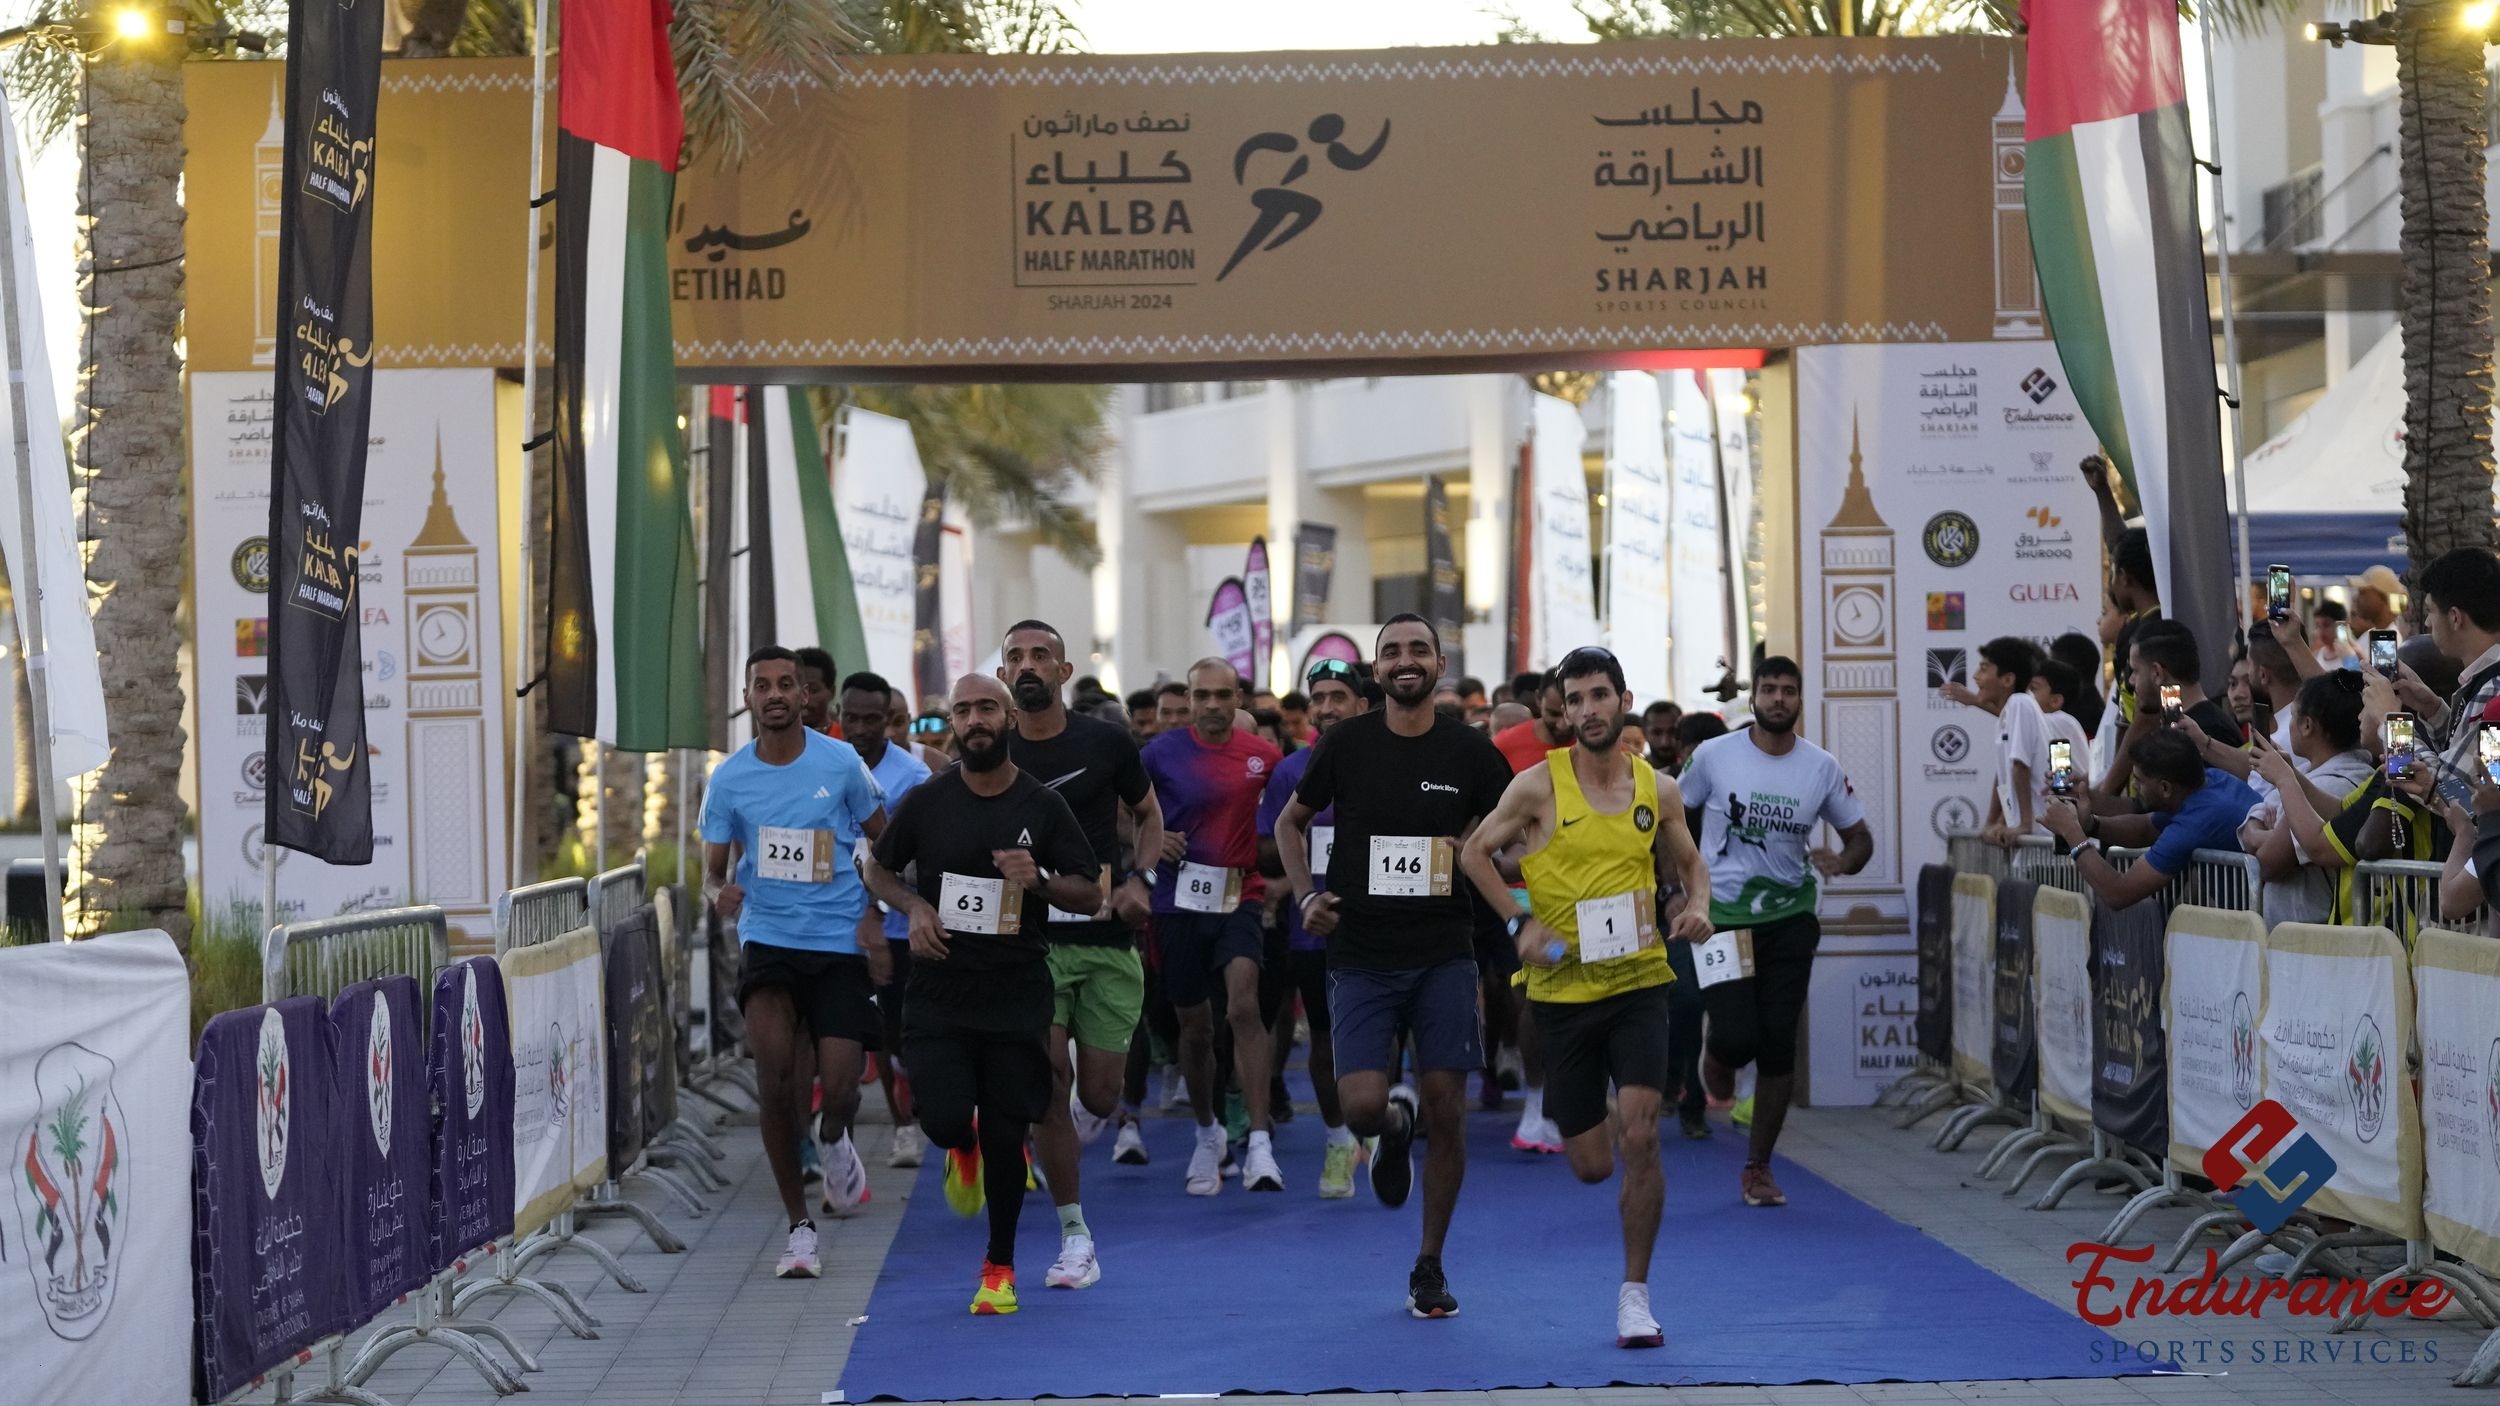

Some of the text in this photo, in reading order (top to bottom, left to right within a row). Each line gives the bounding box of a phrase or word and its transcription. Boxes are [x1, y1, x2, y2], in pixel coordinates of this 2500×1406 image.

[1592, 86, 1763, 134] مجلس
[1023, 110, 1190, 138] نصف ماراثون
[1025, 150, 1191, 193] كلباء
[1595, 146, 1764, 198] الشارقة
[1026, 199, 1193, 236] KALBA
[1595, 201, 1765, 253] الرياضي
[686, 208, 811, 262] عيد
[1024, 248, 1195, 271] HALF MARATHON
[673, 267, 786, 300] ETIHAD
[1596, 265, 1767, 295] SHARJAH
[1048, 294, 1173, 311] SHARJAH 2024
[1597, 298, 1767, 312] SPORTS COUNCIL
[1920, 383, 1977, 398] الشارقة
[1920, 401, 1978, 418] الرياضي
[2015, 549, 2073, 560] SHUROOQ
[2009, 583, 2079, 602] GULFA
[1750, 791, 1800, 807] PAKISTAN
[1749, 802, 1794, 820] ROAD
[767, 843, 804, 862] 226
[1382, 855, 1422, 874] 146
[1190, 879, 1212, 895] 88
[957, 894, 984, 913] 63
[1605, 916, 1614, 936] 1
[1705, 950, 1727, 966] 83
[1861, 1025, 1918, 1046] KAL
[1860, 1055, 1891, 1068] HALF
